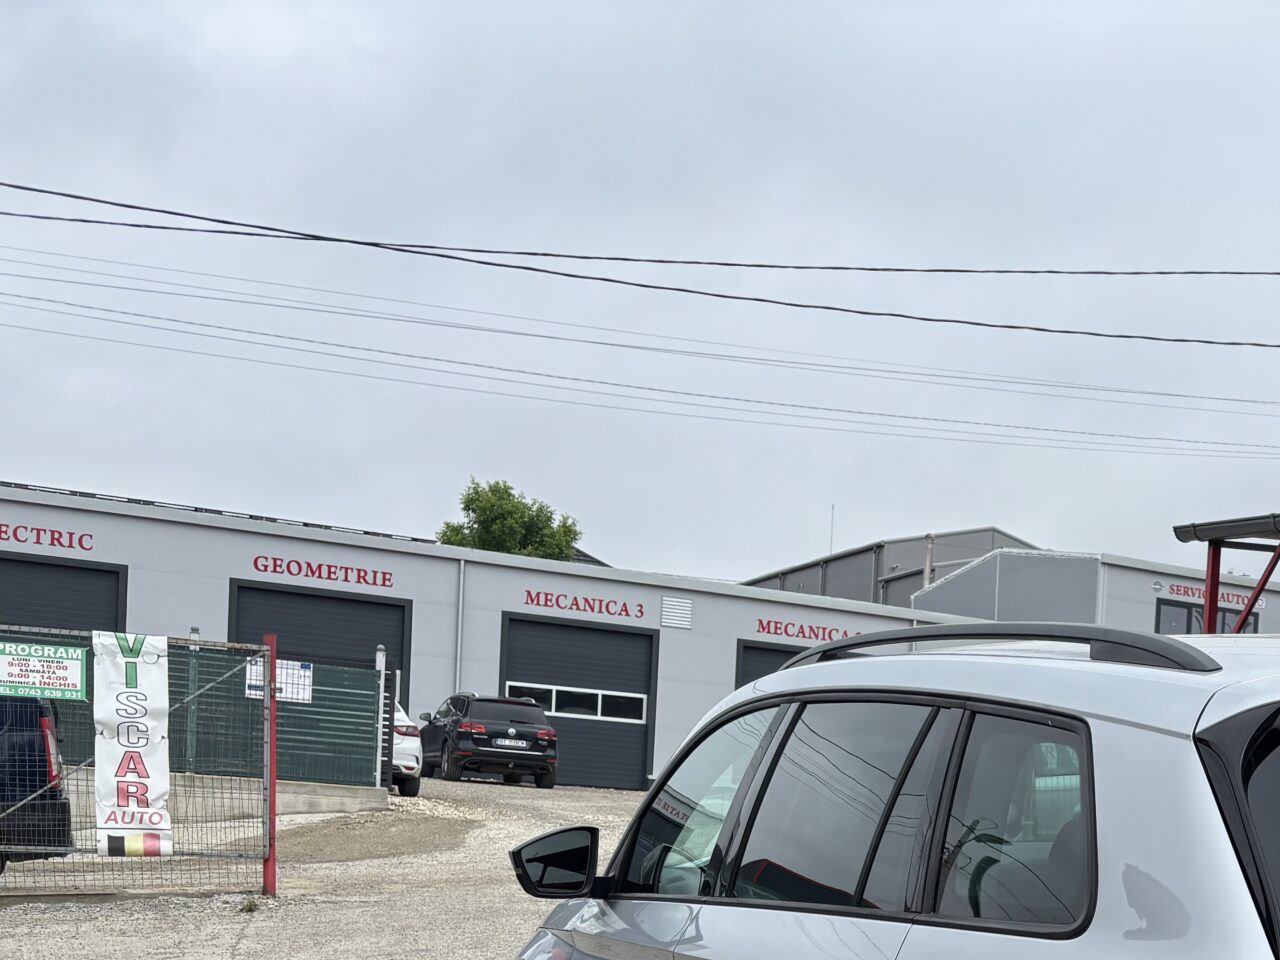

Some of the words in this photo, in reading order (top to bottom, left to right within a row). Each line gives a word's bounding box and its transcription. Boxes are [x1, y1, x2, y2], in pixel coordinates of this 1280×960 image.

[0, 523, 94, 551] ECTRIC
[253, 555, 393, 588] GEOMETRIE
[524, 590, 631, 618] MECANICA
[634, 603, 645, 618] 3
[0, 686, 15, 694] EL:
[18, 688, 41, 696] 0743
[45, 689, 62, 697] 639
[104, 810, 164, 826] AUTO
